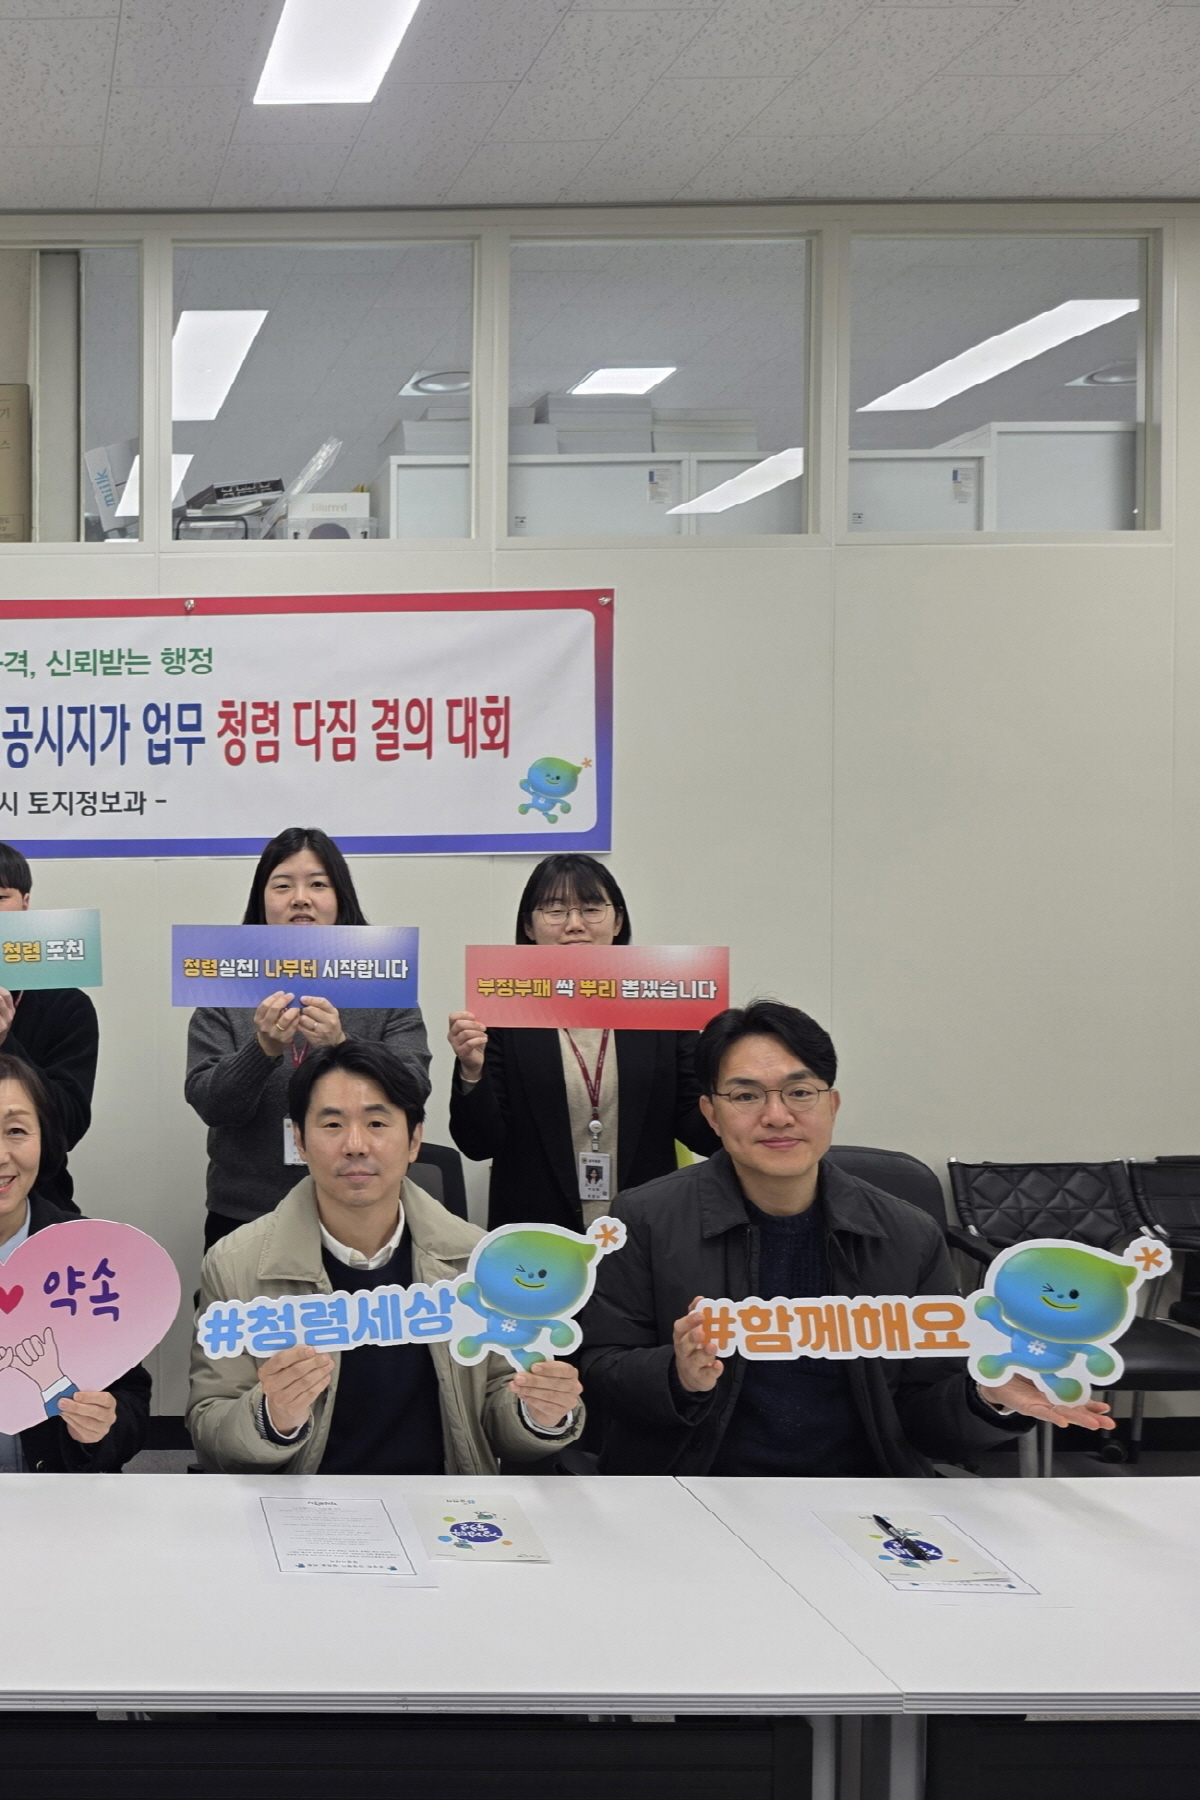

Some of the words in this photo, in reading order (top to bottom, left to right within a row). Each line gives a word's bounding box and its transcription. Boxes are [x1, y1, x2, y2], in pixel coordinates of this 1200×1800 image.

[45, 647, 152, 677] 신뢰받는
[160, 647, 214, 676] 행정
[142, 701, 206, 766] 업무
[216, 698, 280, 767] 청렴
[292, 698, 356, 763] 다짐
[371, 697, 434, 762] 결의
[446, 695, 511, 760] 대회
[27, 790, 147, 817] 토지정보과
[3, 941, 41, 963] 청렴
[46, 938, 85, 962] 포천
[182, 957, 260, 979] 청렴실천!
[265, 958, 318, 980] 나부터
[321, 958, 409, 980] 시작합니다
[477, 977, 552, 1000] 부정부패
[556, 978, 575, 999] 싹
[579, 978, 616, 999] 뿌리
[621, 979, 717, 1000] 뽑겠습니다
[43, 1257, 120, 1322] 약속
[204, 1286, 457, 1354] #청렴세상
[701, 1302, 970, 1353] #함께해요
